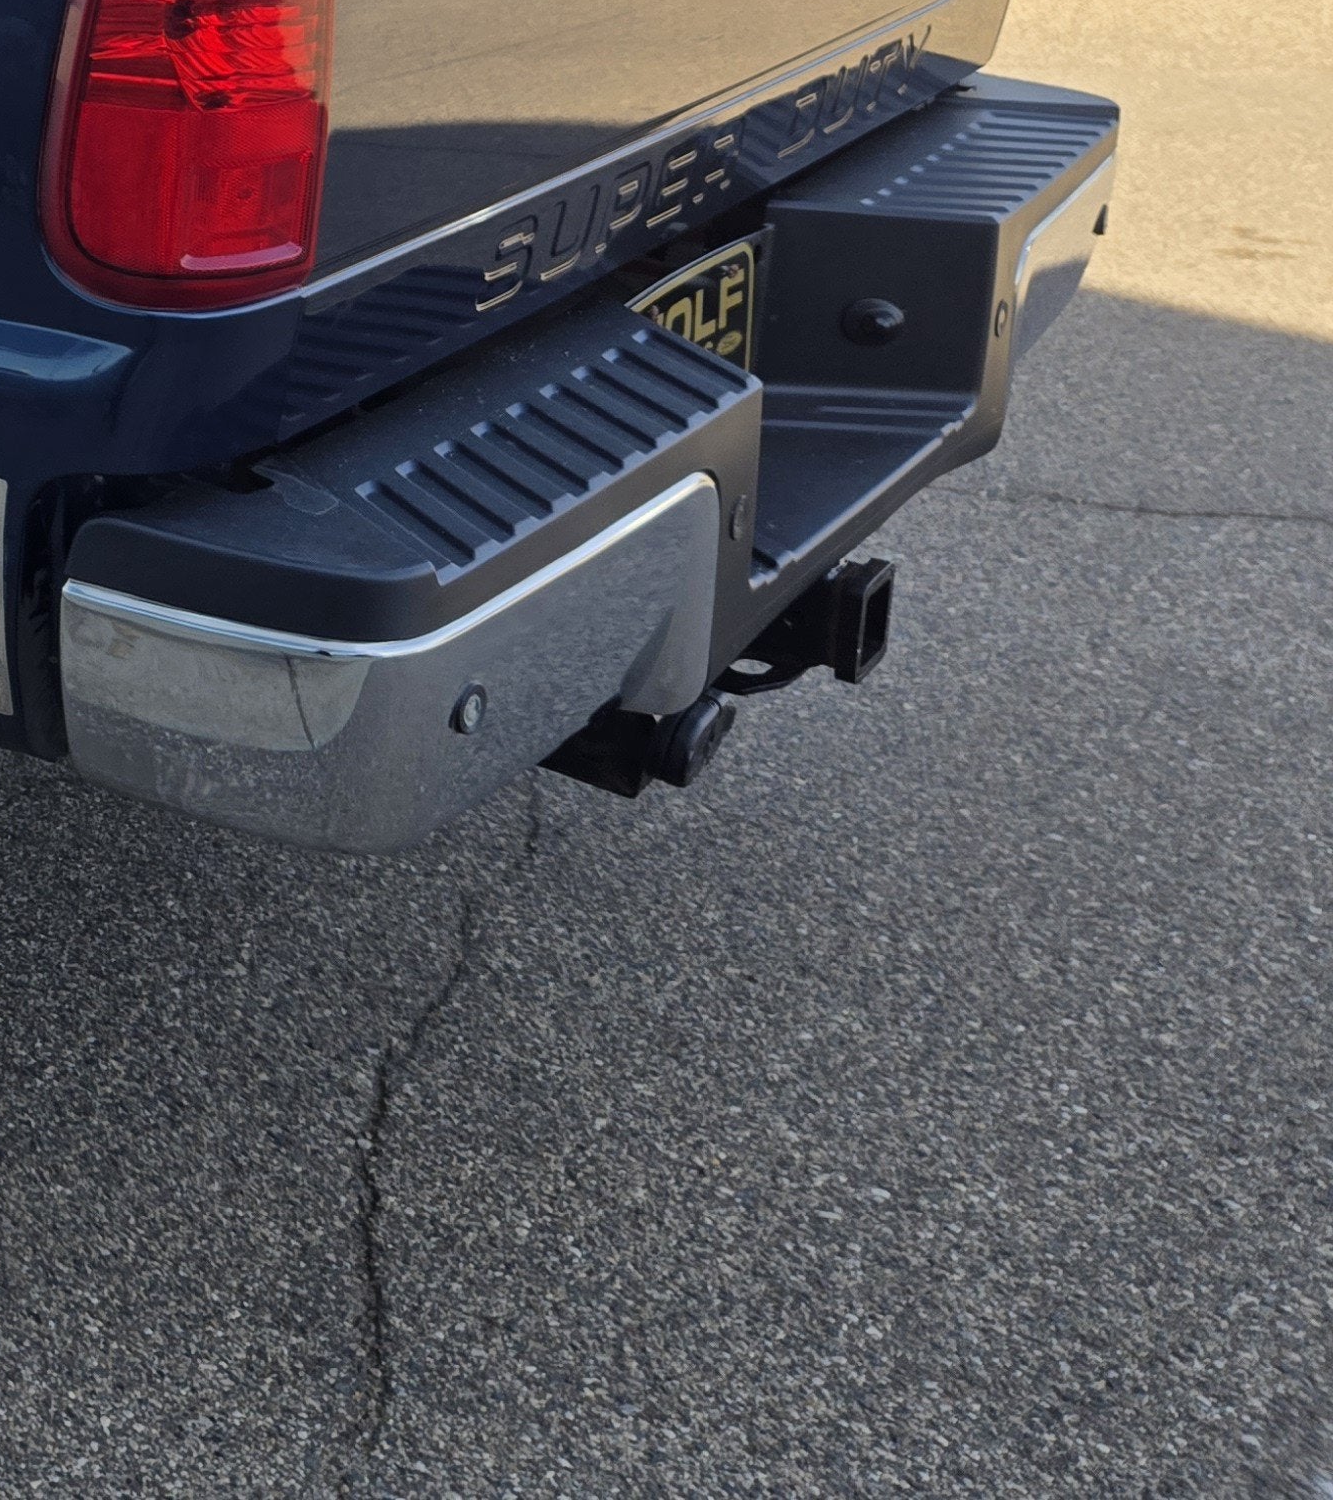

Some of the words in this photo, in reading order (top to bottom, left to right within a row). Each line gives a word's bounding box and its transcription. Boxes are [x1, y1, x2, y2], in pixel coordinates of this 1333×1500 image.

[476, 114, 745, 312] SUPER
[778, 23, 932, 161] DUTY
[657, 268, 745, 343] OLF
